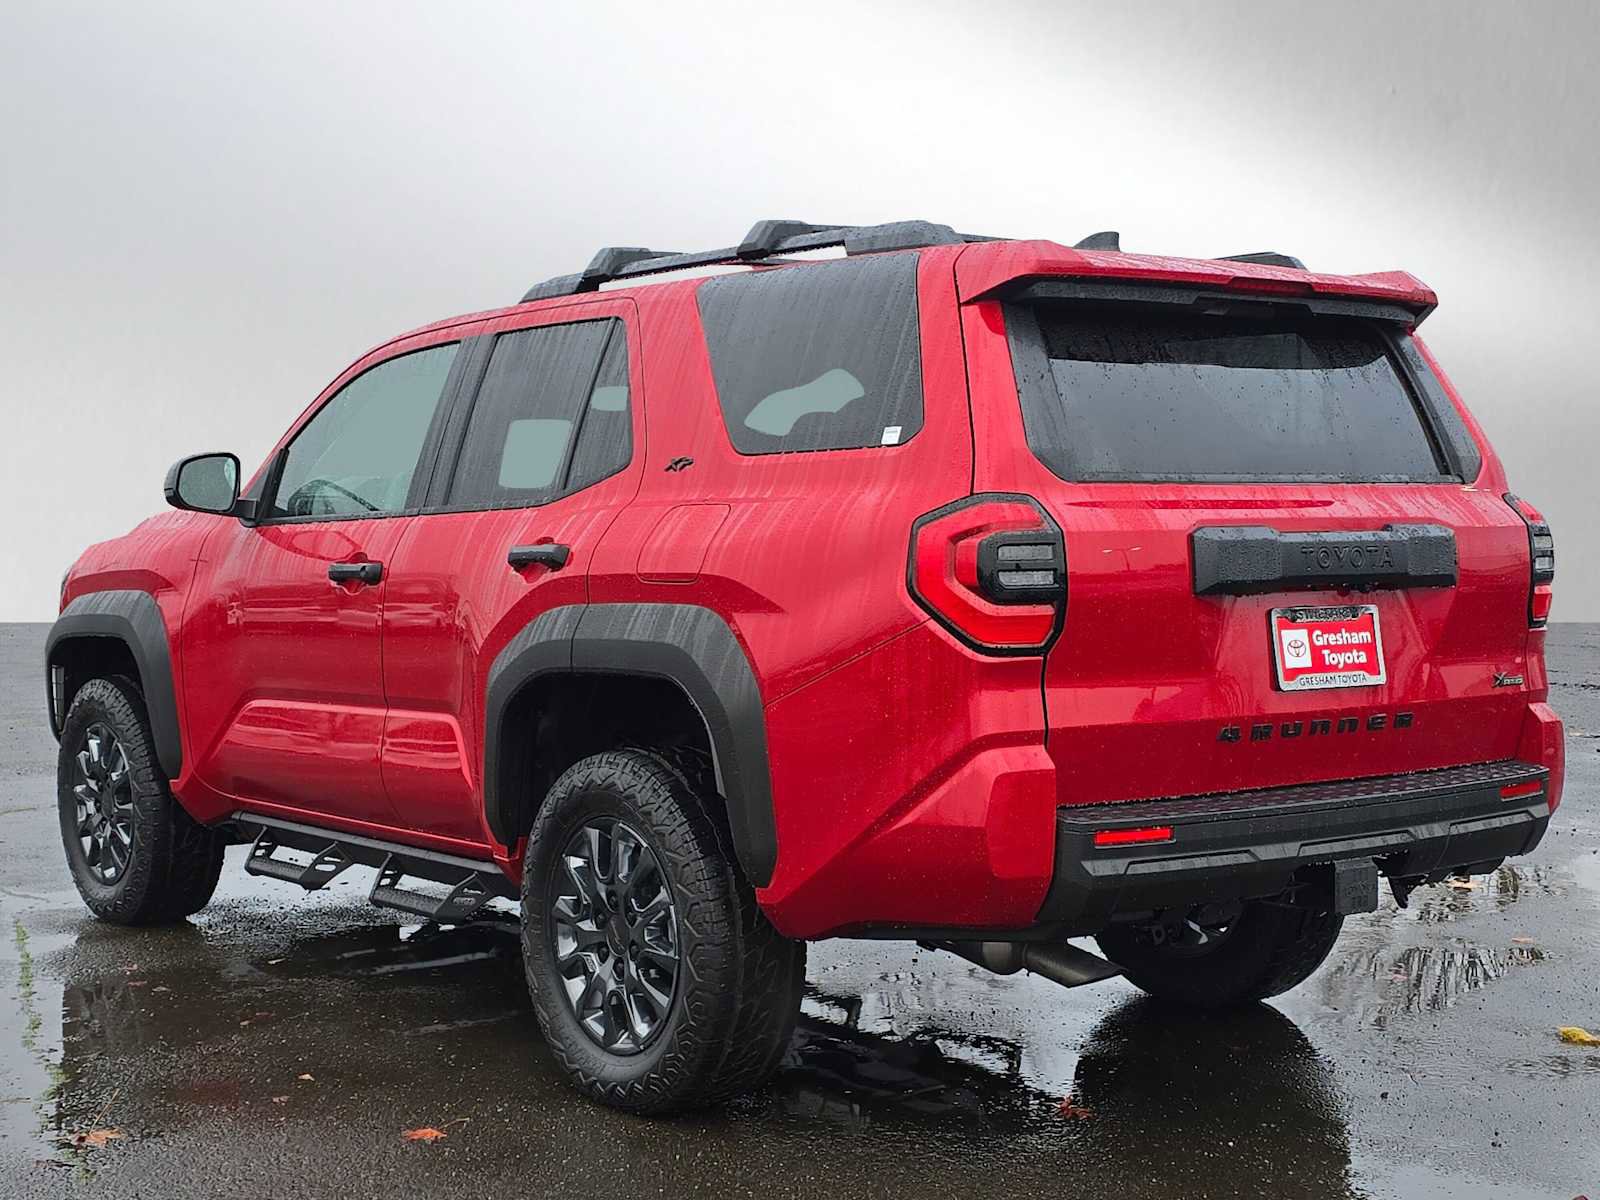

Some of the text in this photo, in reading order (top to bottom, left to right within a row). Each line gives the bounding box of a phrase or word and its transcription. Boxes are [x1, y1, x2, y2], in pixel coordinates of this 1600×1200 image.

[1301, 544, 1395, 570] TOYOTA
[1312, 629, 1372, 646] Gresham
[1321, 650, 1367, 669] Toyota
[1299, 674, 1367, 687] GRESHAM TOYOTA
[1216, 711, 1415, 743] 4RUNNER
